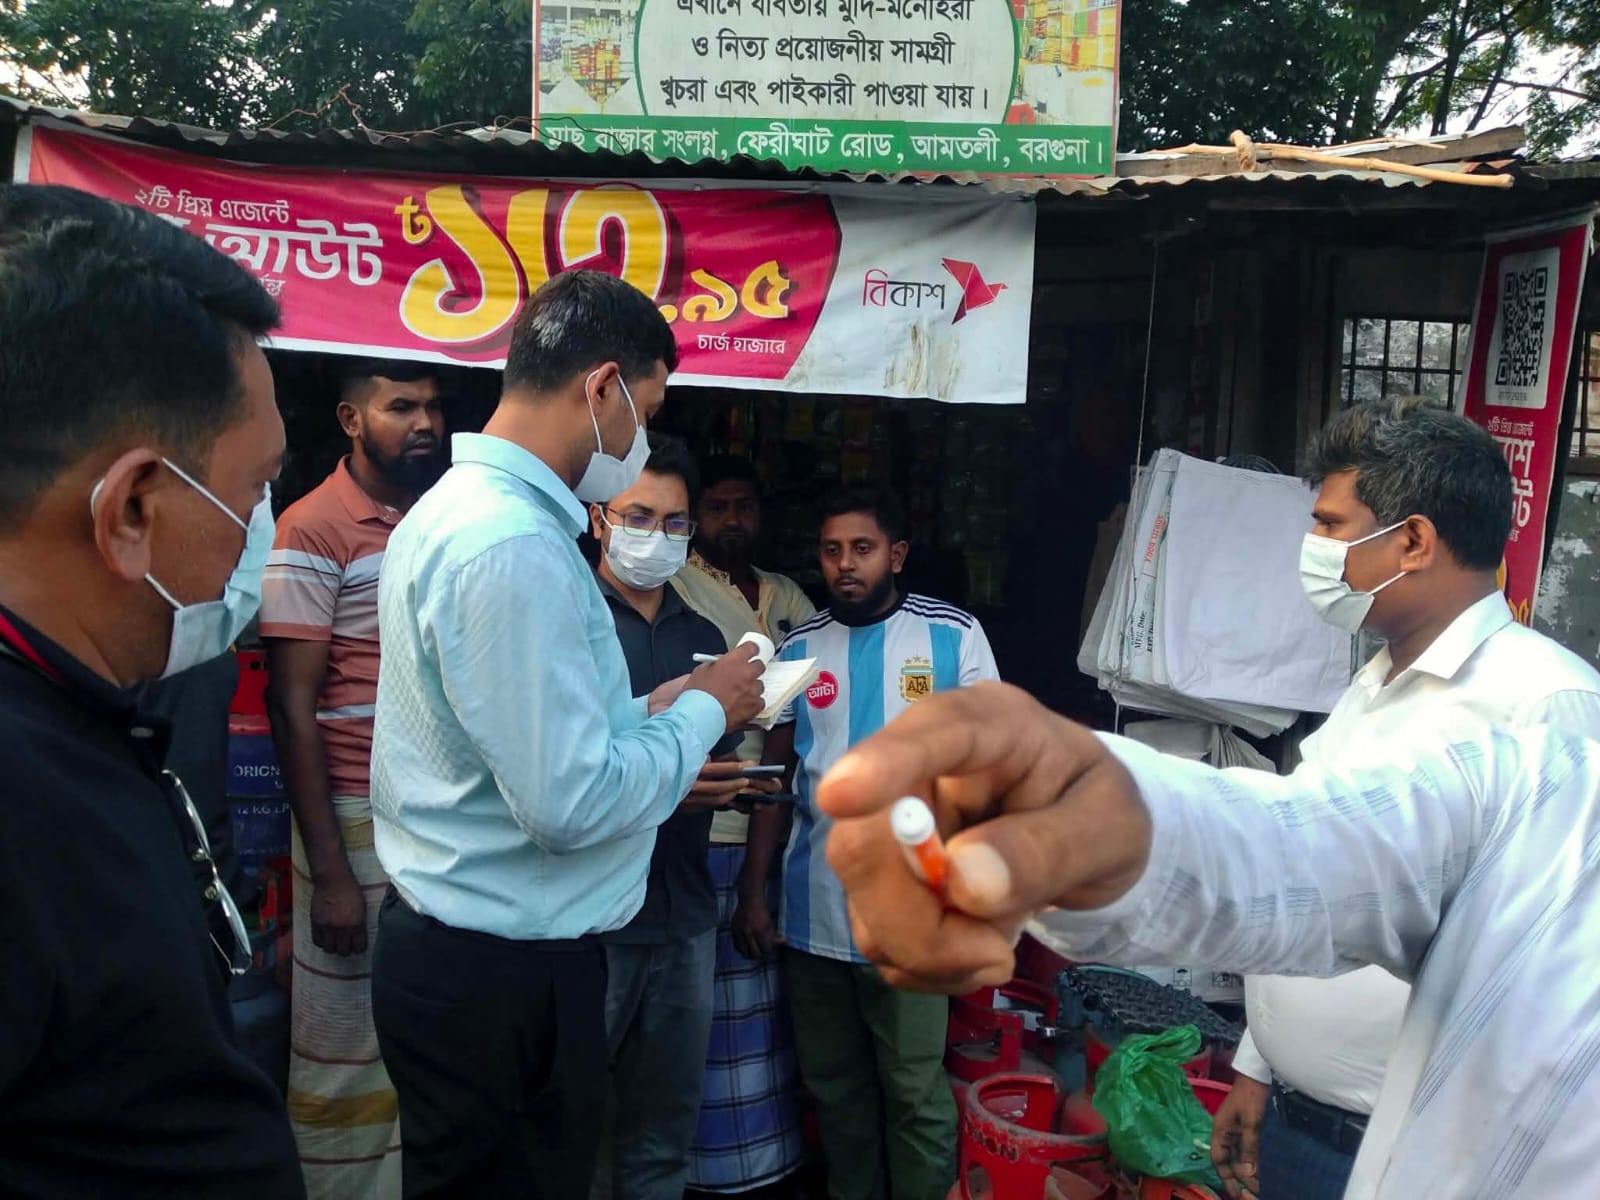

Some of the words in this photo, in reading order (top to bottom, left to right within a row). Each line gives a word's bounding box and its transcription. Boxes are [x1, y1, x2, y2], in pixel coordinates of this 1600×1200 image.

[691, 37, 709, 56] ও
[716, 28, 769, 60] নিত্য
[775, 29, 884, 64] প্রয়োজনীয়
[889, 32, 956, 65] সামগ্রী
[660, 75, 708, 108] খুচরা
[714, 79, 760, 106] এবং
[767, 73, 856, 107] পাইকারী
[863, 80, 928, 108] পাওয়া
[545, 125, 586, 152] মাছ
[593, 126, 657, 155] বাজার
[737, 121, 834, 157] ফেরীঘাট
[134, 185, 173, 208] ২টি
[177, 190, 213, 217] প্রিয়
[219, 199, 290, 223] এজেন্টে
[862, 268, 945, 310] বিকাশ
[697, 332, 730, 352] চার্জ
[733, 337, 786, 354] হাজারে
[808, 682, 835, 699] আটা
[908, 676, 929, 694] AFA
